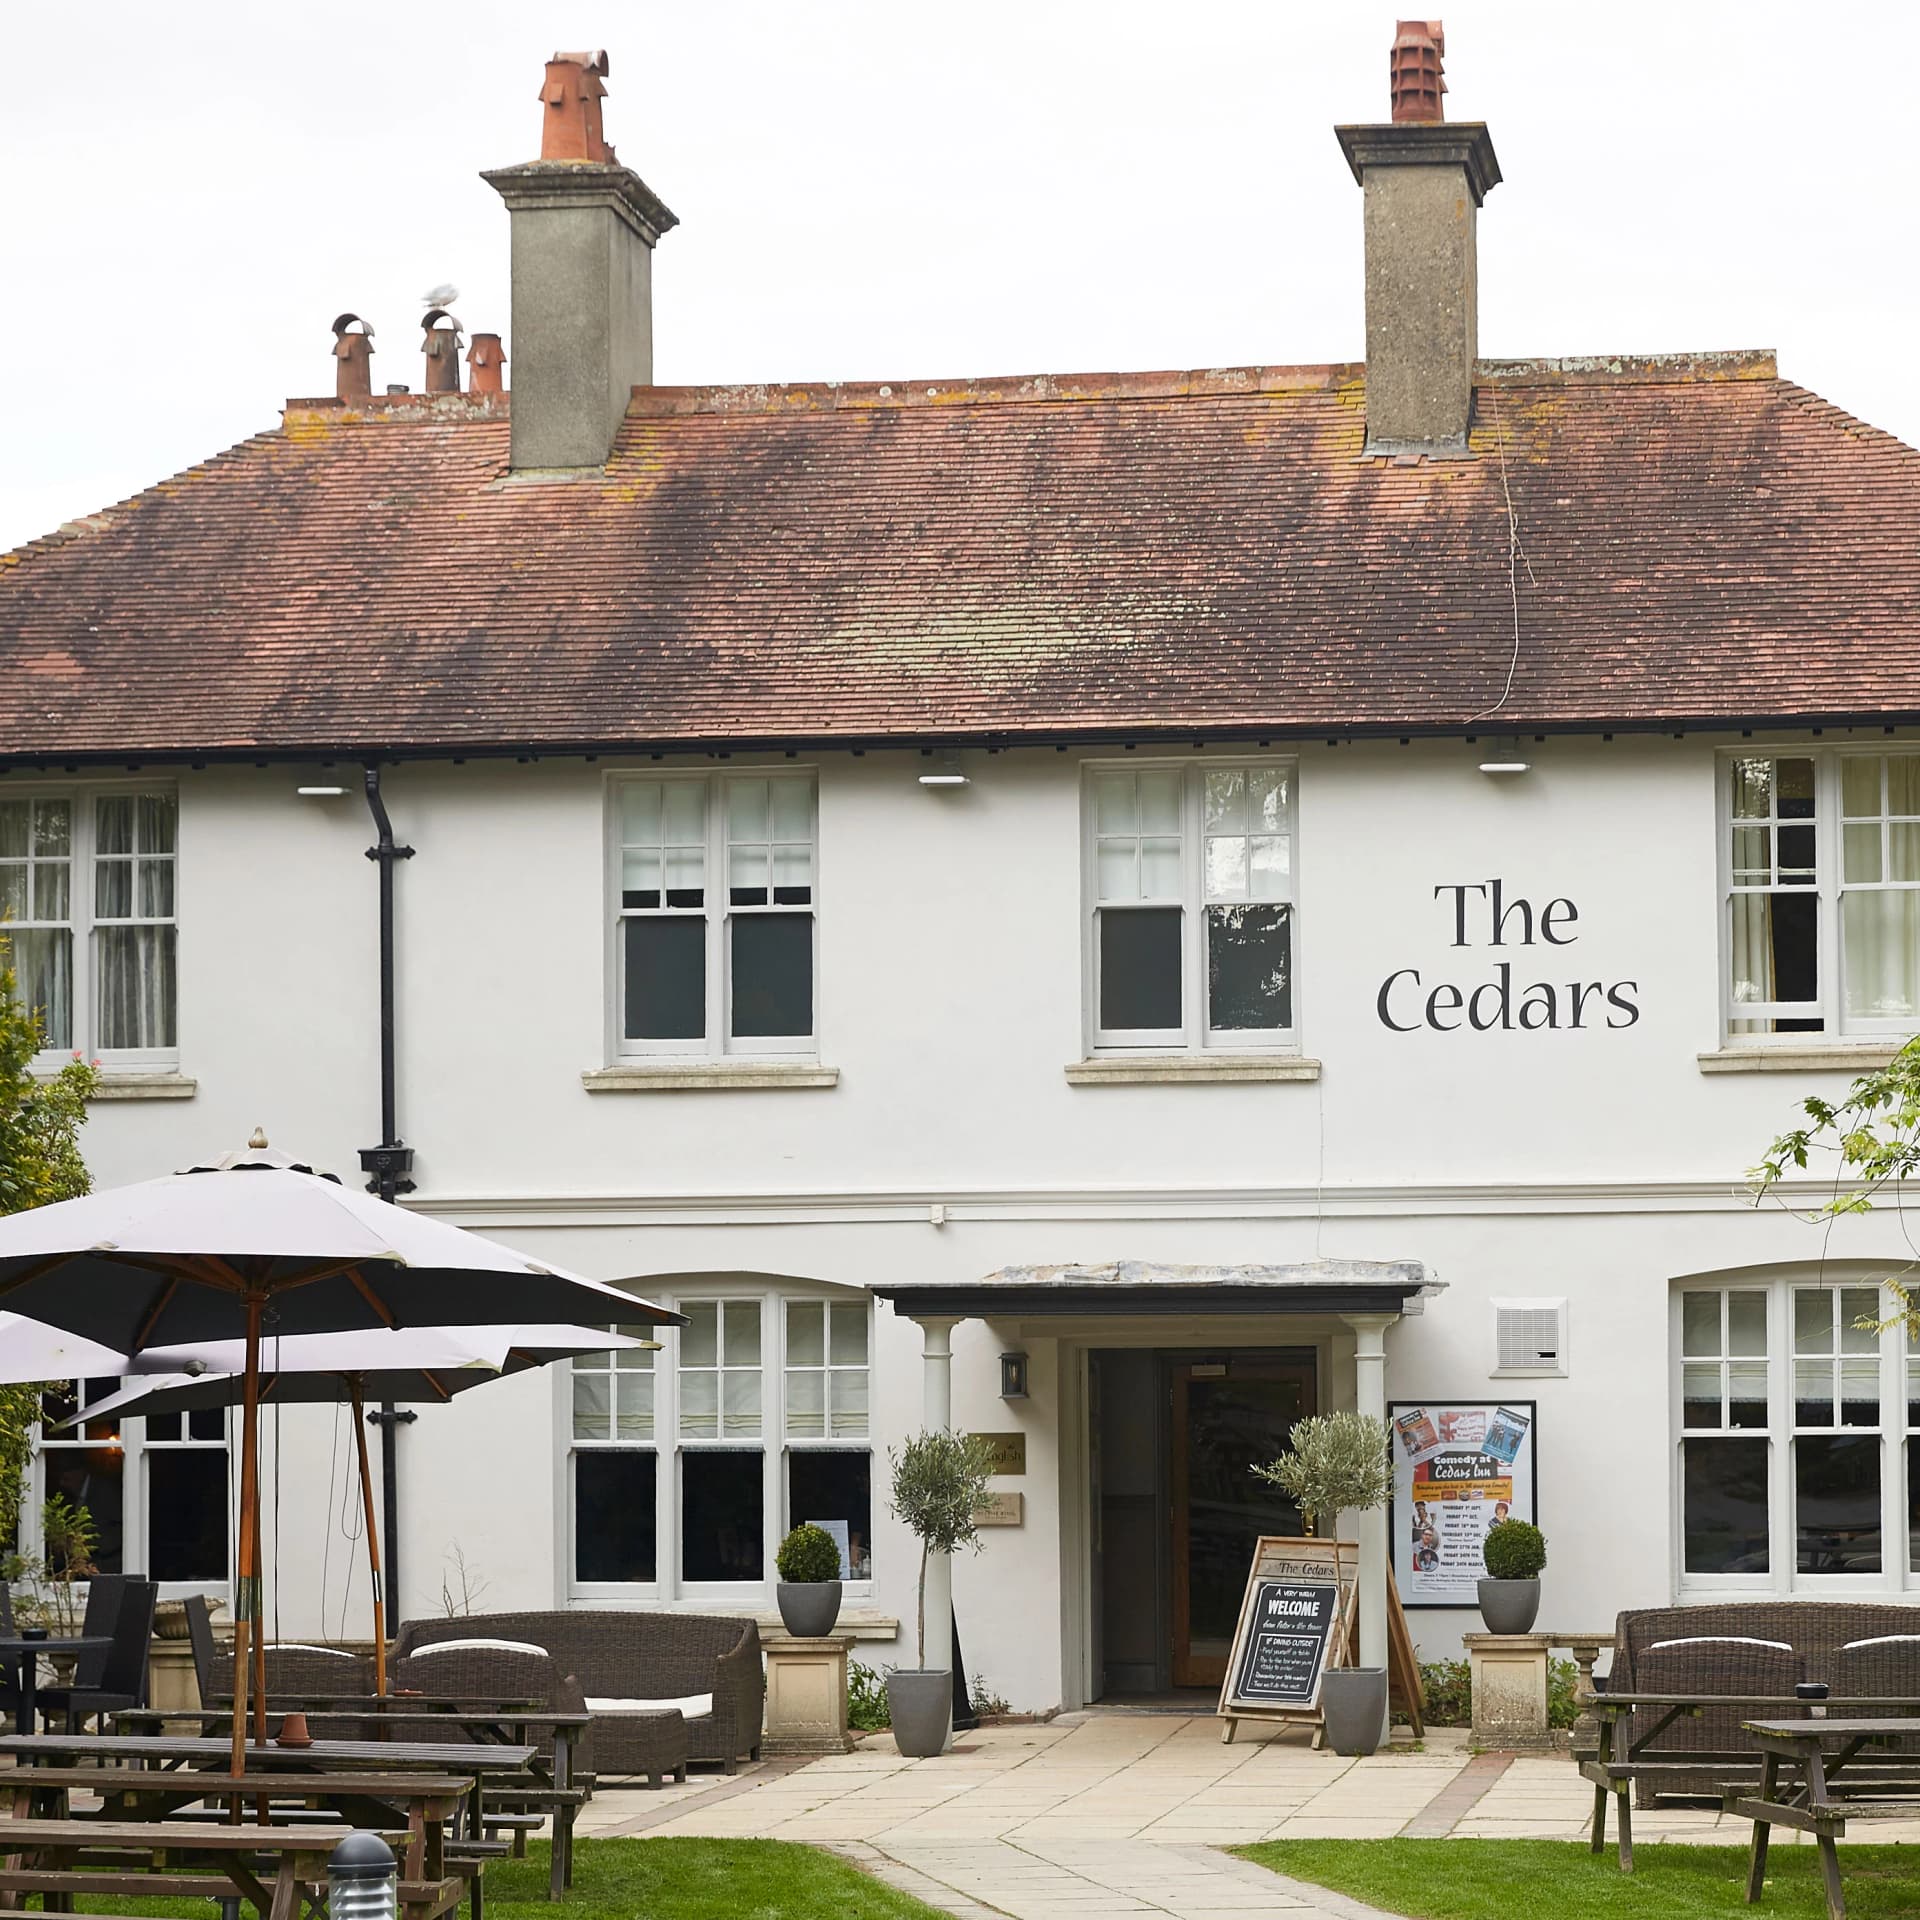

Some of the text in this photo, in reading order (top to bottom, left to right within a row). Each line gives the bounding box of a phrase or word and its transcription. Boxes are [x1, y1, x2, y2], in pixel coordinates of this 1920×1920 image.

[1434, 878, 1579, 947] The
[1377, 962, 1640, 1032] Cedars
[1433, 1455, 1491, 1465] Comedy at
[1435, 1464, 1491, 1478] Cedars Inn
[1279, 1562, 1335, 1576] The Cedars
[1275, 1588, 1281, 1596] A
[1268, 1599, 1321, 1617] WELCOME
[1273, 1638, 1292, 1646] DINING
[1292, 1639, 1314, 1647] OUTSIDE
